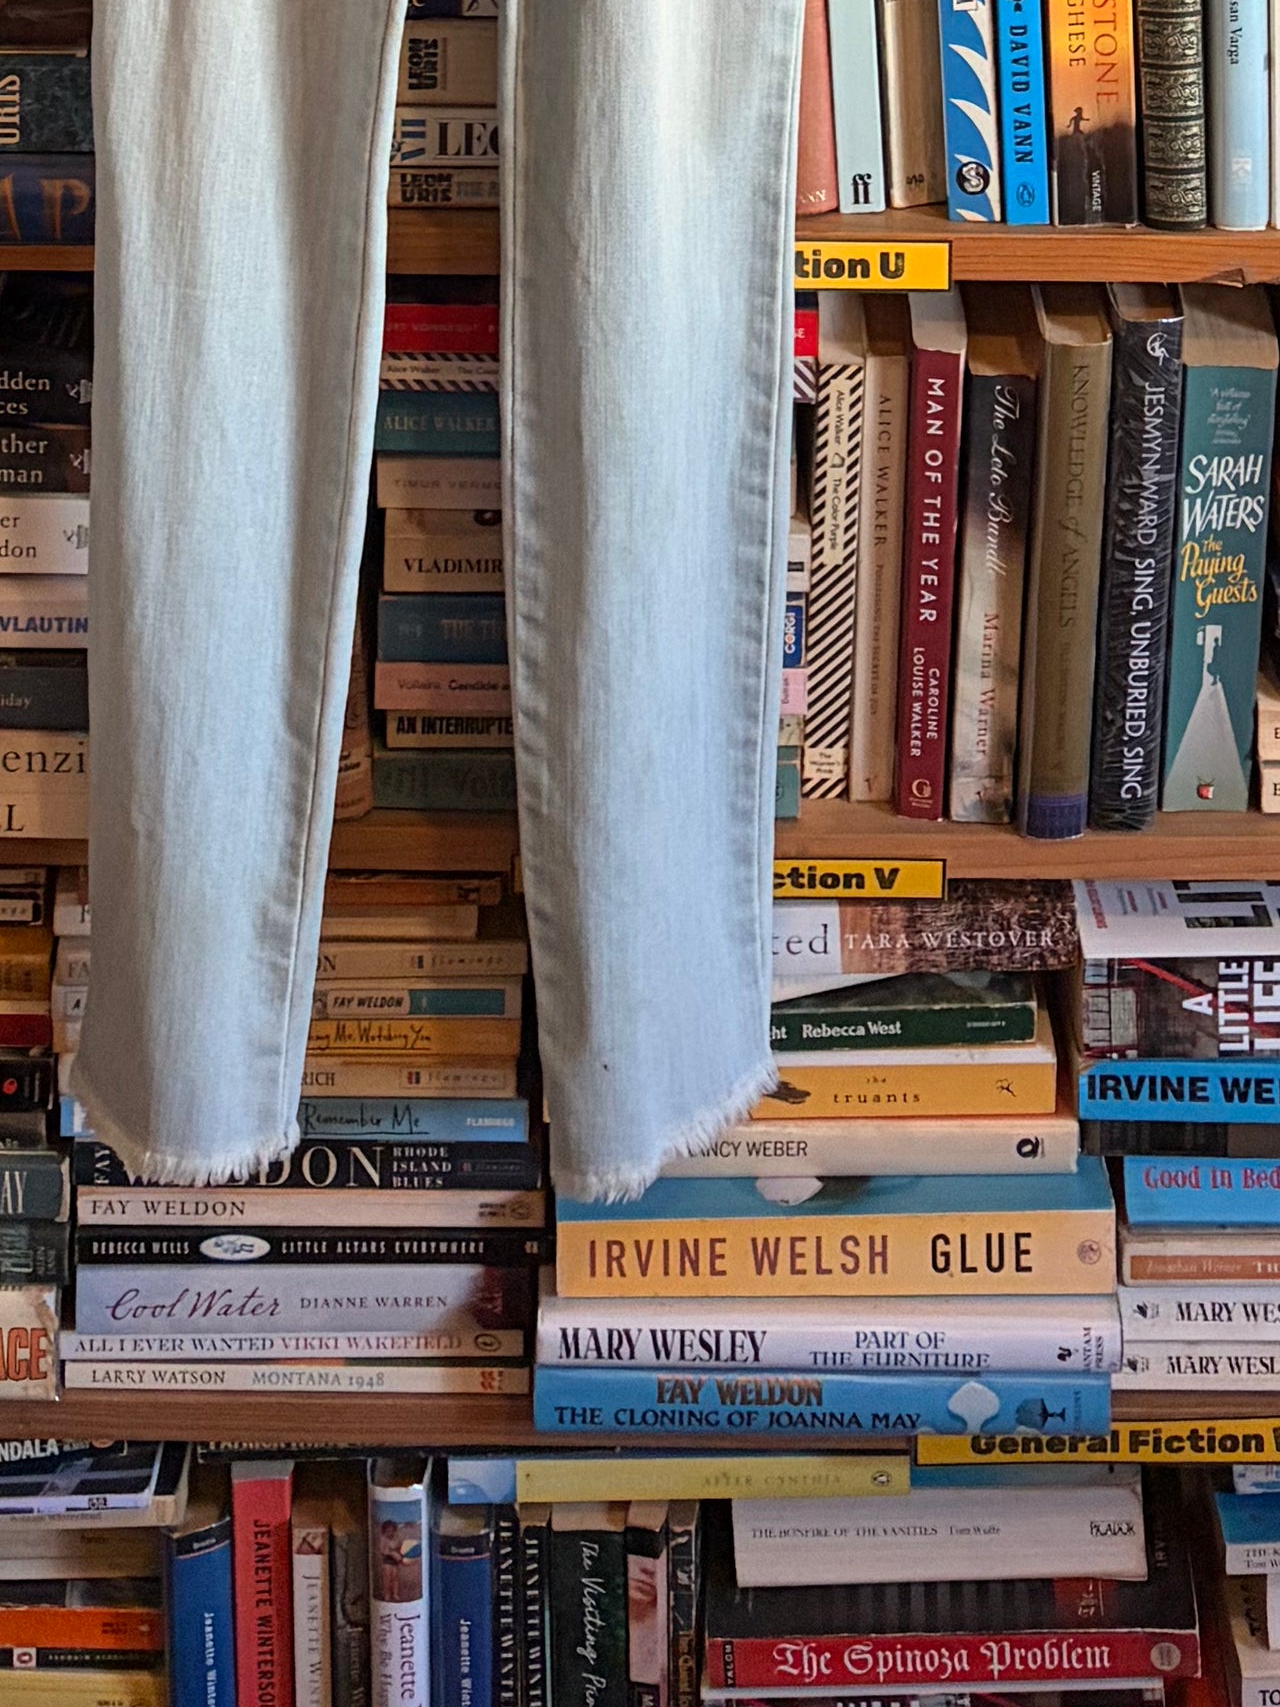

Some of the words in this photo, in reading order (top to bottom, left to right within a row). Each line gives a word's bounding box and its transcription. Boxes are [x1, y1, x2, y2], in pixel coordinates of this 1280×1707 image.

[1183, 453, 1262, 493] SARAH
[1181, 492, 1266, 541] WATERS
[1086, 1074, 1212, 1107] IRVINE
[588, 1236, 738, 1279] IRVINE
[751, 1234, 892, 1277] WELSH
[930, 1230, 1033, 1275] GLUE
[773, 1639, 833, 1678] The
[980, 1638, 1113, 1674] Problem
